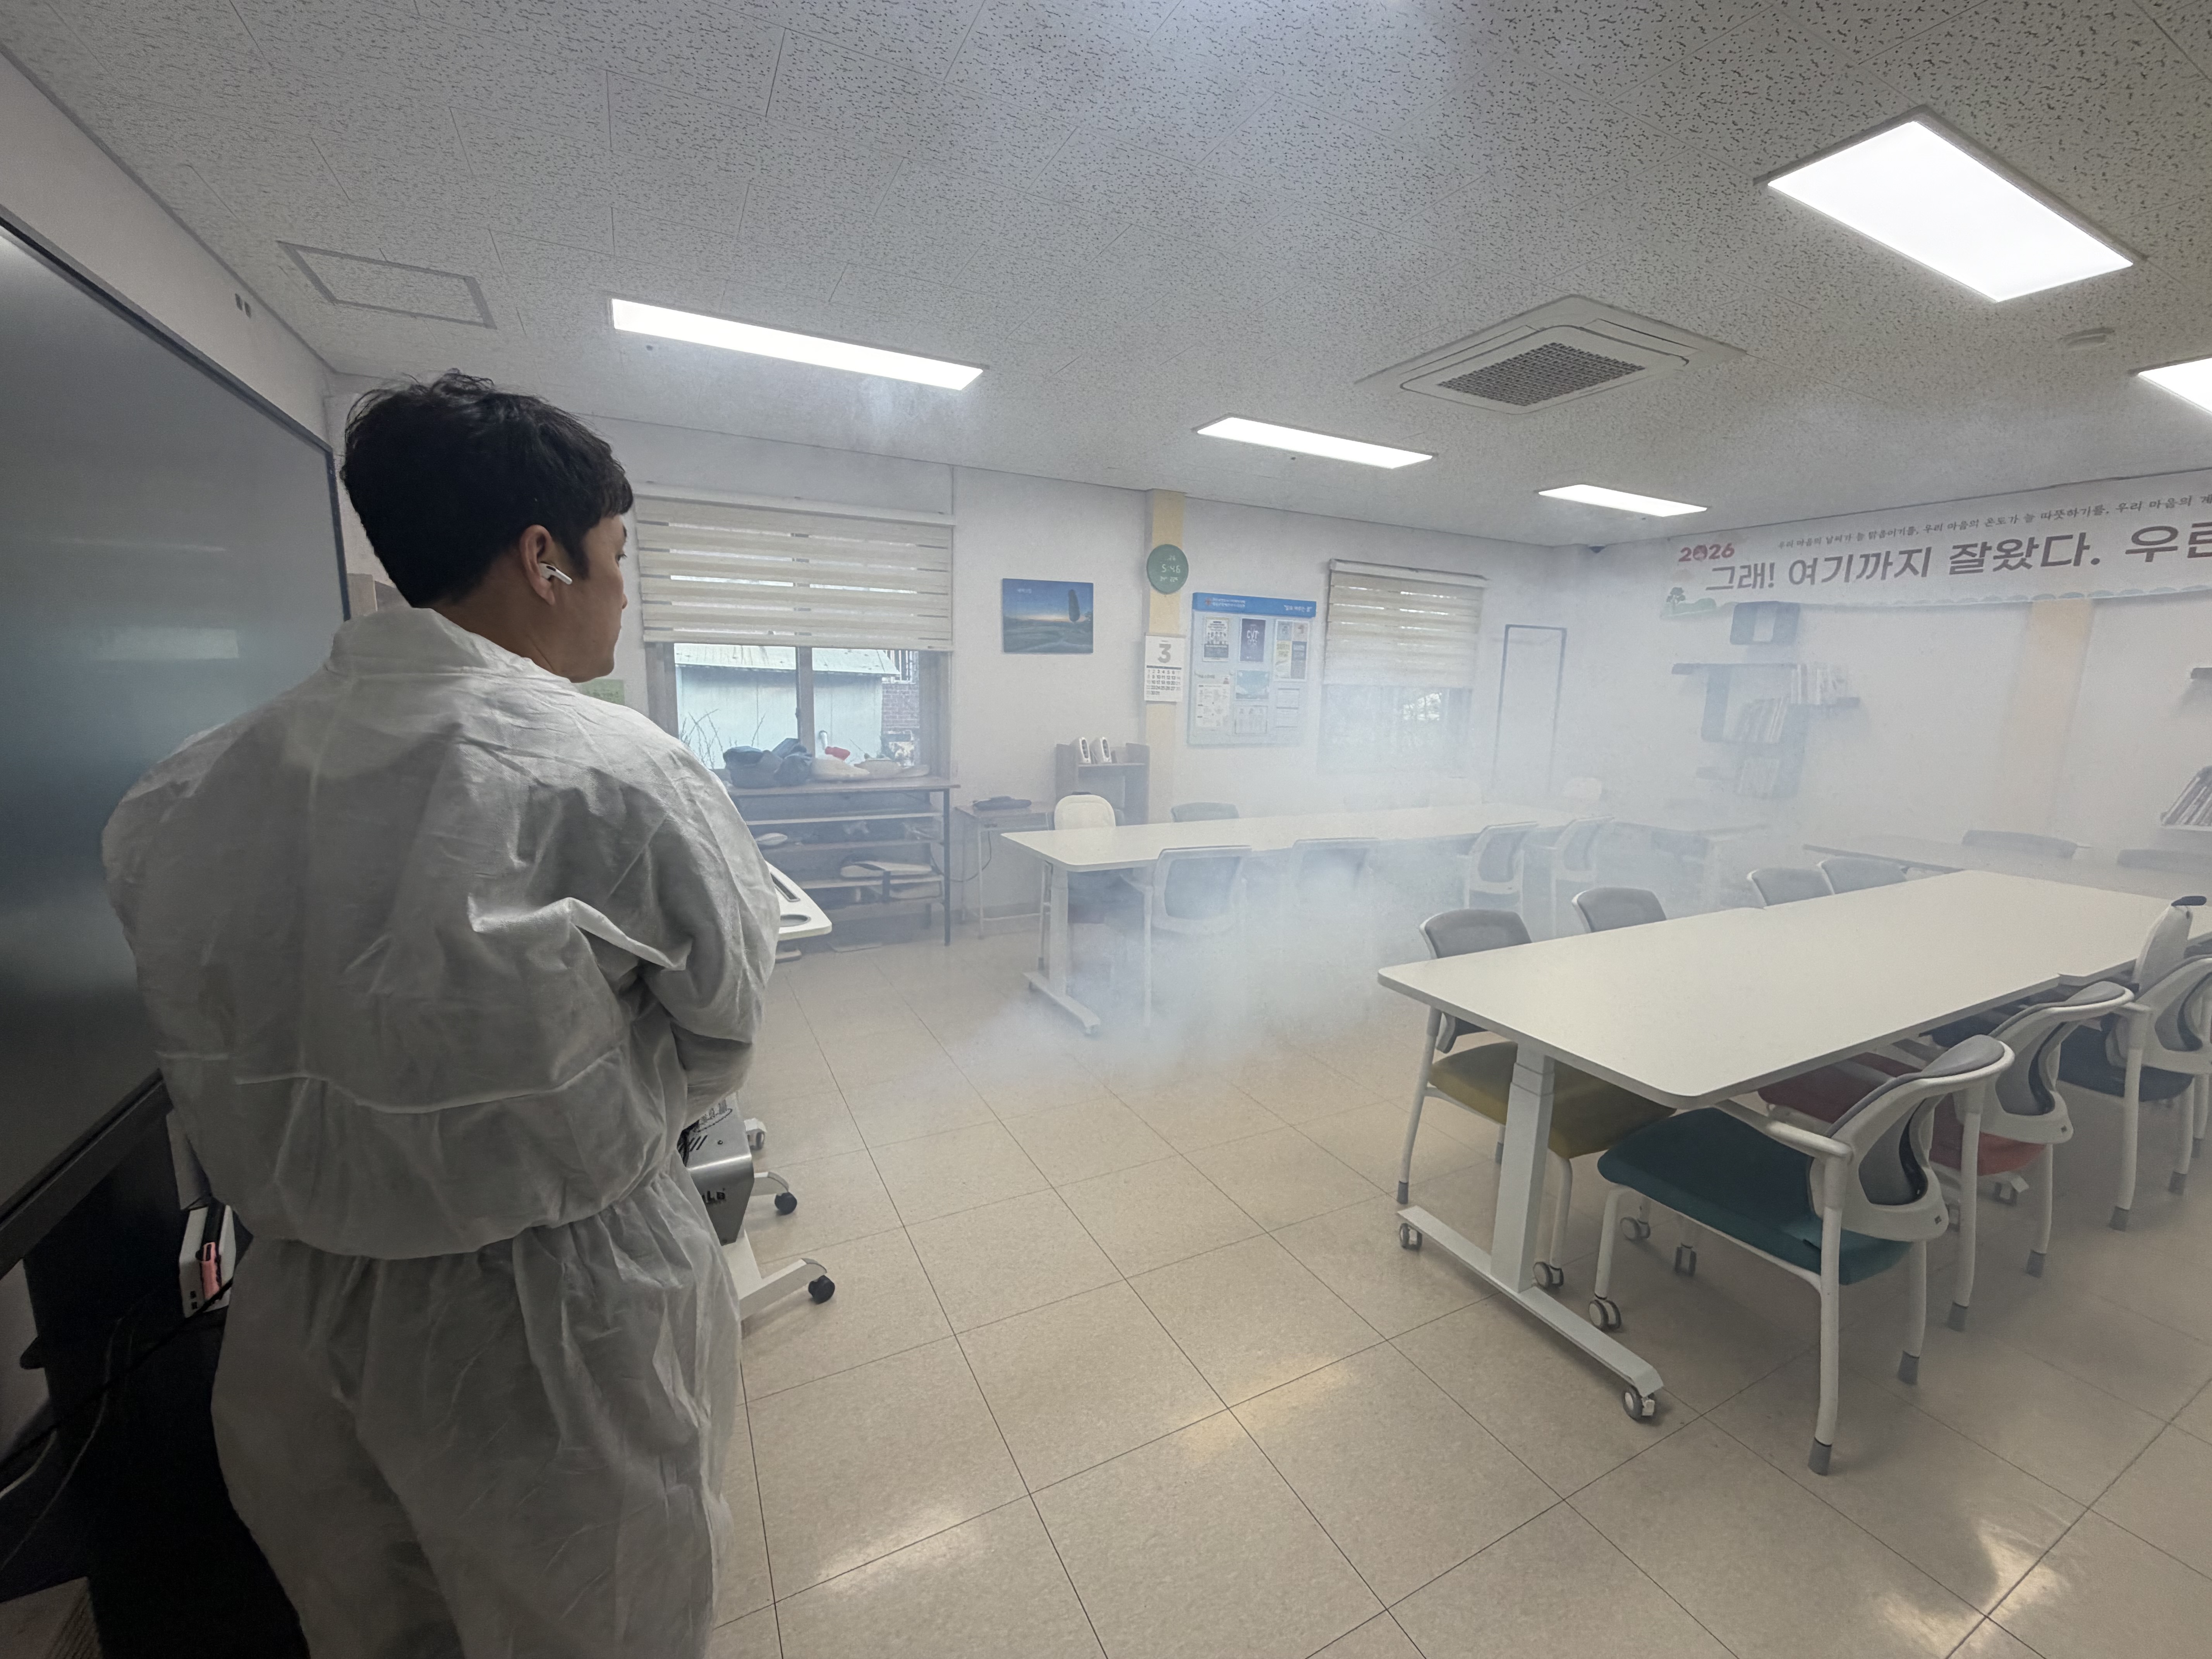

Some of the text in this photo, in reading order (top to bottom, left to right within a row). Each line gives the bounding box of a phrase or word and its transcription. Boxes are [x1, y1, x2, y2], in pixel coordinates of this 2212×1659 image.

[1796, 537, 1822, 546] 마음의
[1826, 533, 1852, 544] 날씨가
[1923, 523, 1943, 533] 우리
[1947, 519, 1979, 531] 마음의
[1985, 514, 2019, 527] 온도가
[2024, 513, 2036, 523] 늘
[2116, 500, 2142, 513] 우리
[2148, 495, 2193, 509] 마음의
[1705, 562, 1775, 591] 그래!
[1788, 546, 1932, 586] 여기까지
[1949, 532, 2101, 575] 잘왔다.
[1158, 643, 1171, 663] 3
